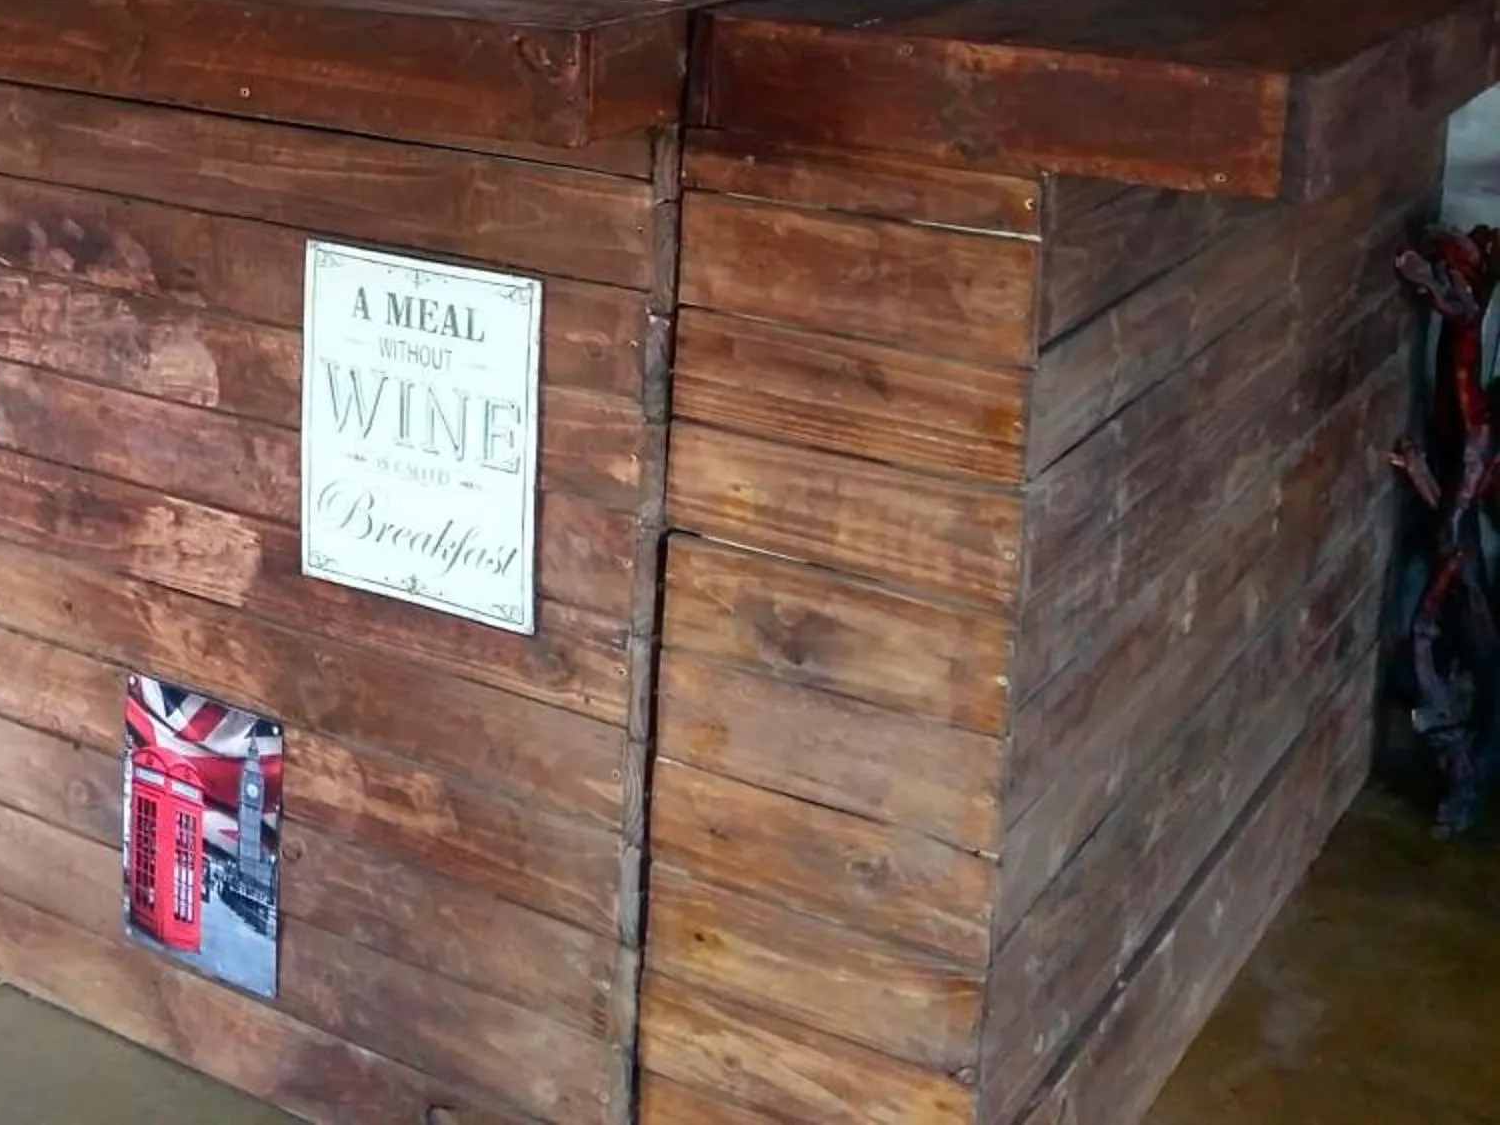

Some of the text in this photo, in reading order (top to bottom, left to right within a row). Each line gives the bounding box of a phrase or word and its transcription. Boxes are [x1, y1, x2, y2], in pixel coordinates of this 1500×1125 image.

[350, 285, 486, 343] A MEAL
[378, 336, 454, 371] WITHOUT
[320, 357, 522, 475] WINE
[317, 479, 519, 576] Breakfast
